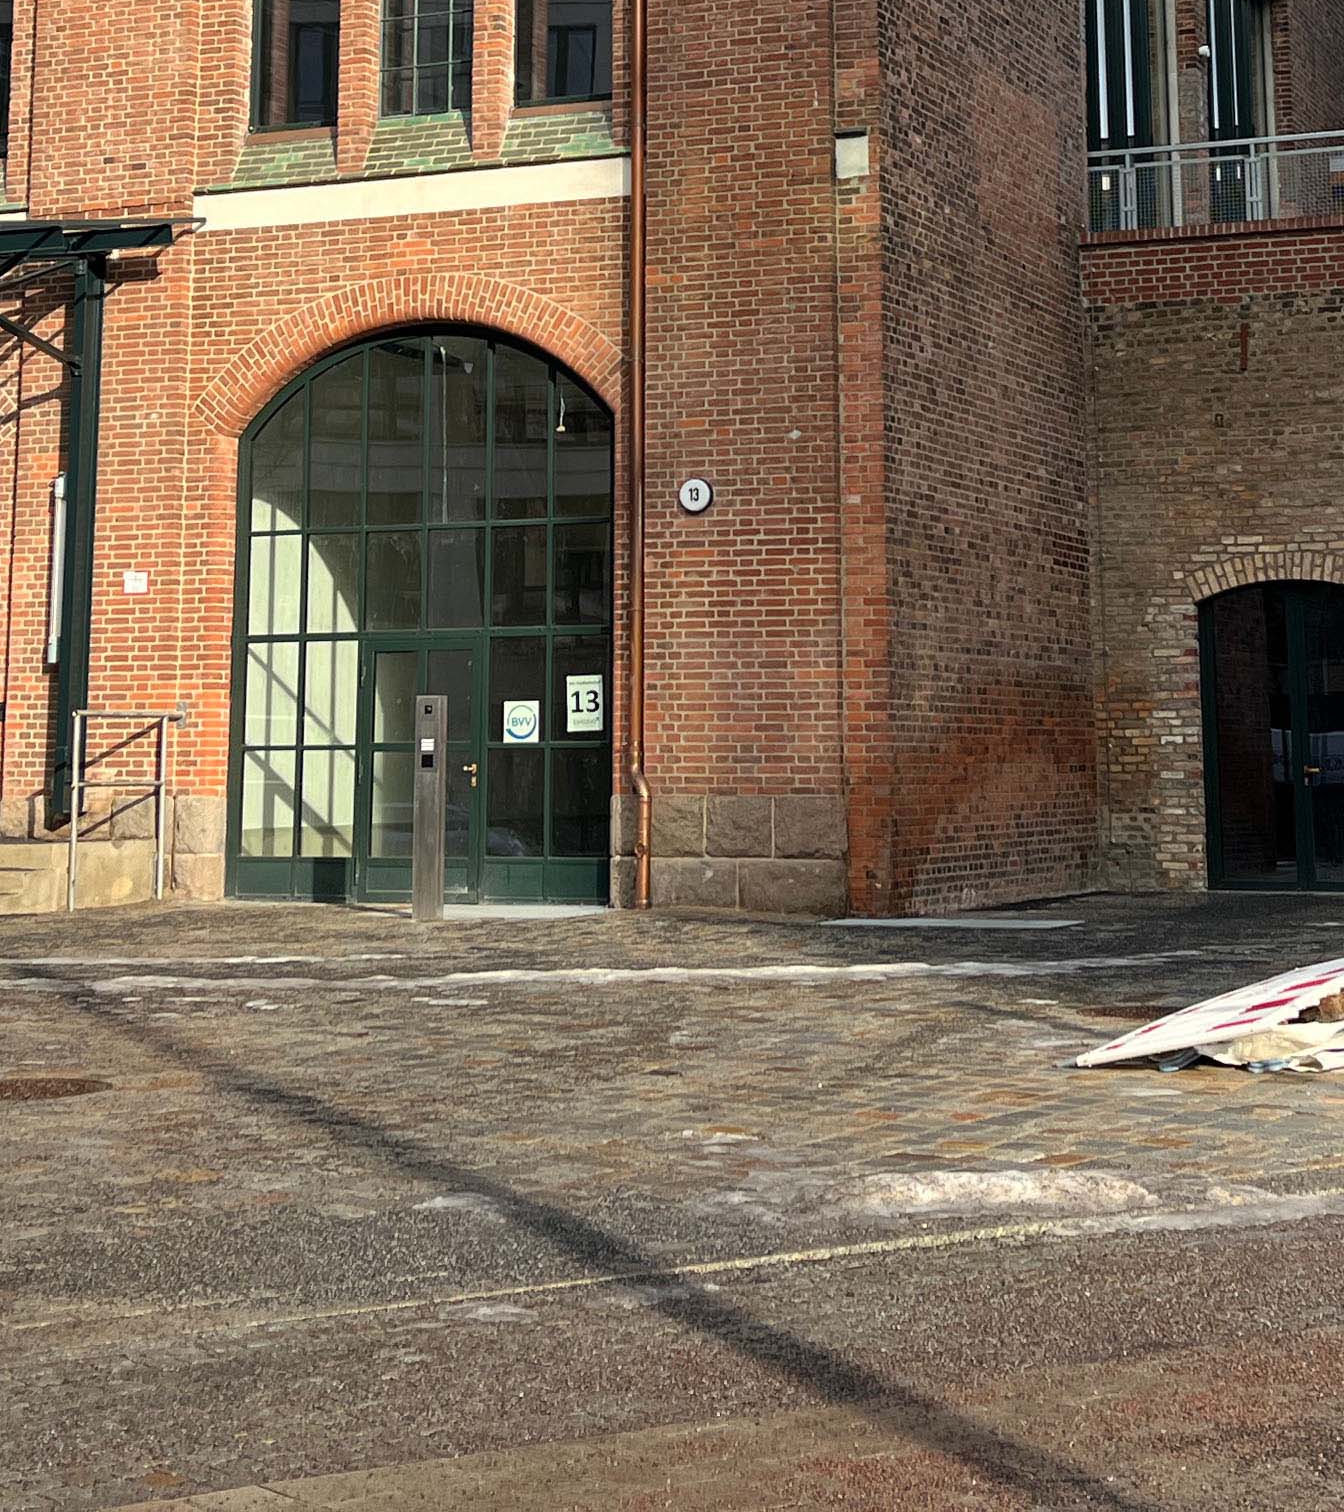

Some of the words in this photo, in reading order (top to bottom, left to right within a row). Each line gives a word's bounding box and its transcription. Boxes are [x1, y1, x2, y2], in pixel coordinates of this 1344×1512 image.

[688, 487, 700, 502] 13
[571, 689, 600, 713] 13
[511, 717, 532, 727] BVV
